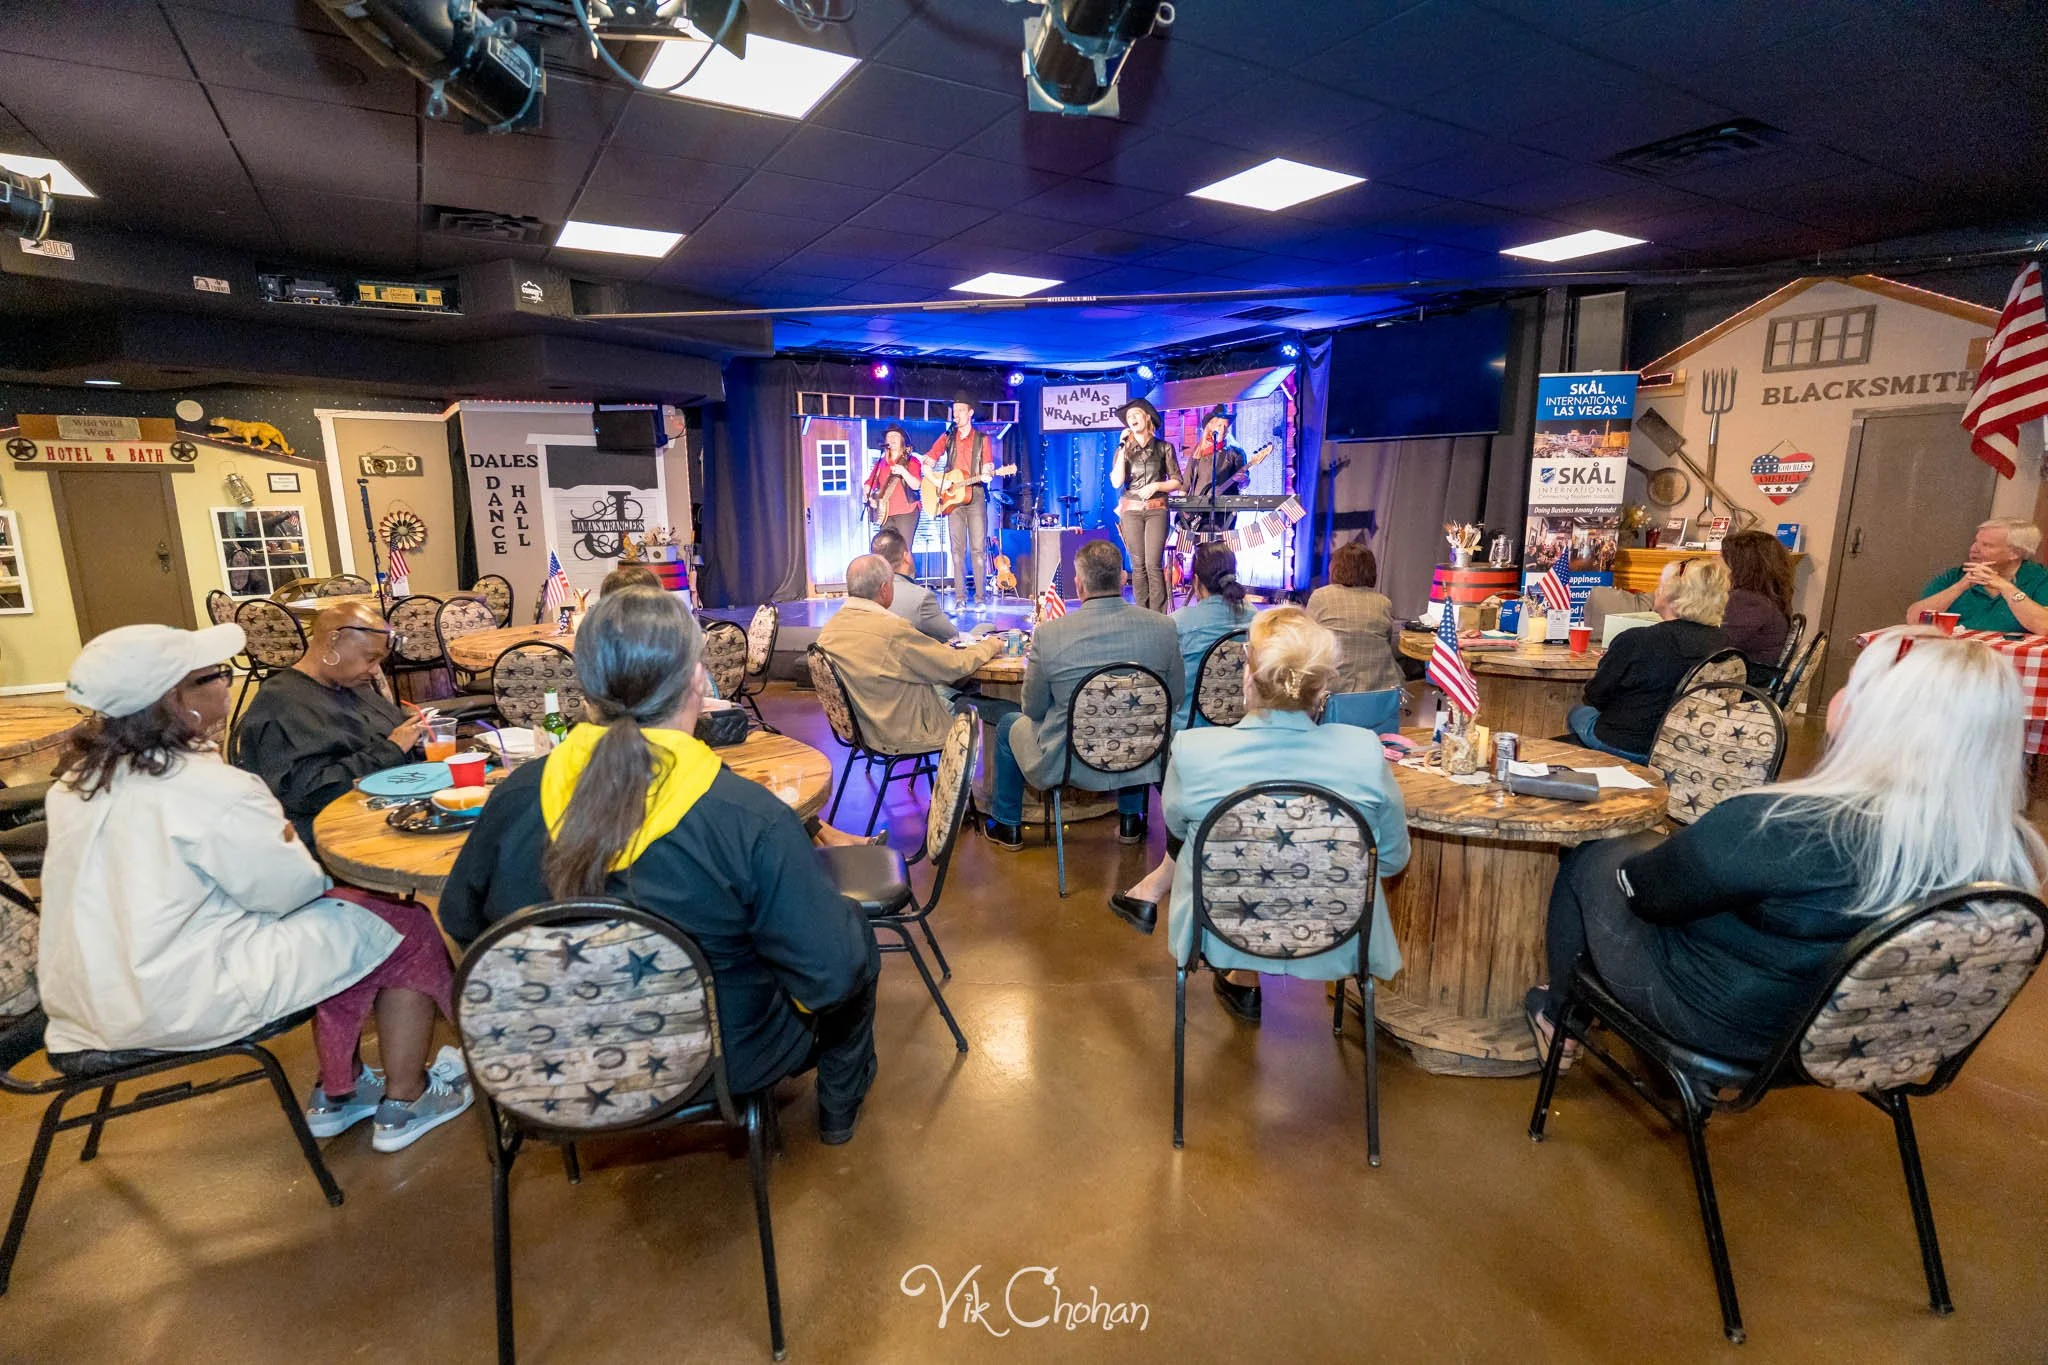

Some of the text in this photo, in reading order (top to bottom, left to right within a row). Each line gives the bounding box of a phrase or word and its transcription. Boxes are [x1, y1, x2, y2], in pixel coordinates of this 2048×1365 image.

[1570, 380, 1606, 395] SKÅL
[1761, 371, 1978, 405] BLACKSMITH
[1057, 387, 1110, 406] MAMAS
[1545, 396, 1628, 406] INTERNATIONAL
[1044, 405, 1121, 427] WRANGLER
[1554, 405, 1618, 416] LAS VEGAS
[45, 446, 164, 463] HOTEL & BATH
[470, 454, 538, 468] DALES
[361, 456, 417, 474] RODO
[1558, 462, 1616, 484] SKÅL
[486, 476, 507, 554] DANCE
[512, 485, 530, 547] HALL
[1534, 506, 1550, 514] Doing
[1574, 506, 1593, 514] Among
[1569, 574, 1601, 585] appiness
